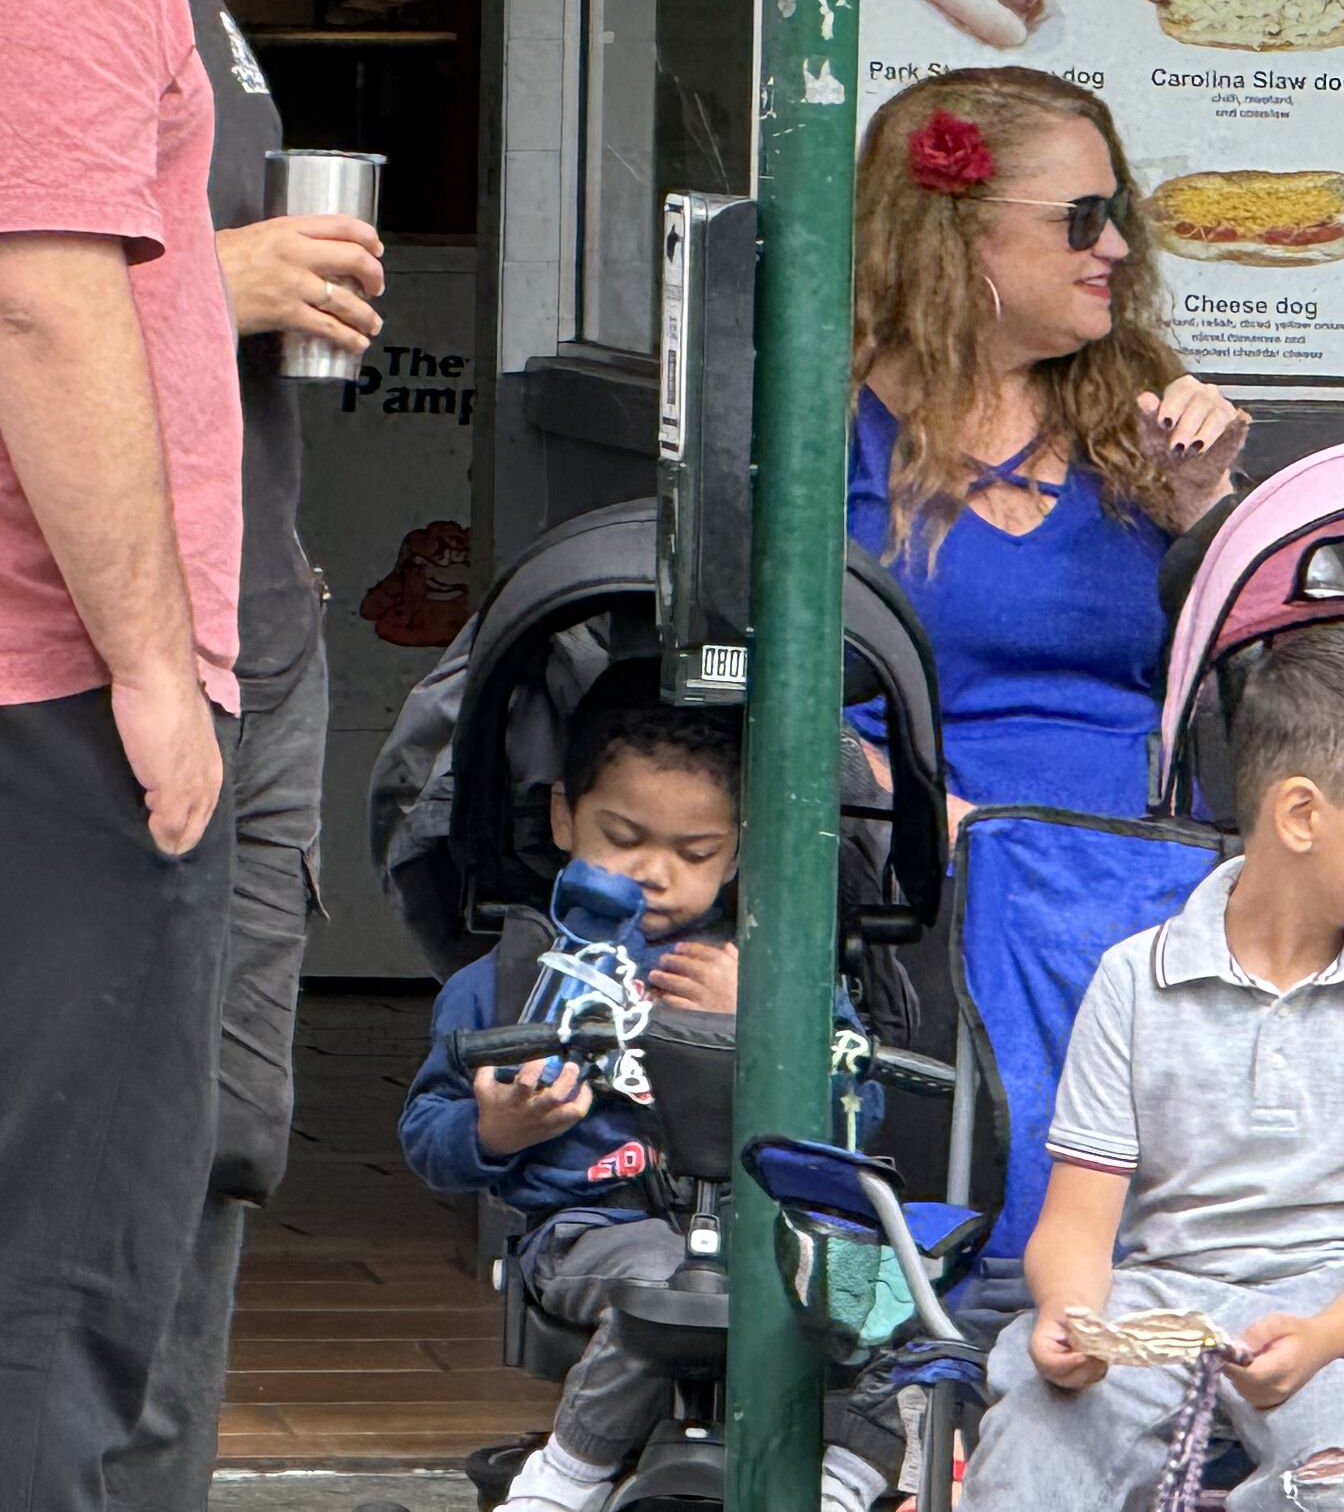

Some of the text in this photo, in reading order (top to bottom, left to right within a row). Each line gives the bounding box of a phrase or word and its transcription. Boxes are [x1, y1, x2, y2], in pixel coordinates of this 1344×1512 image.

[870, 61, 919, 83] Park
[1064, 66, 1105, 89] dog
[1152, 68, 1344, 93] Carolina Slaw do
[1185, 294, 1318, 320] Cheese dog
[384, 346, 465, 378] The
